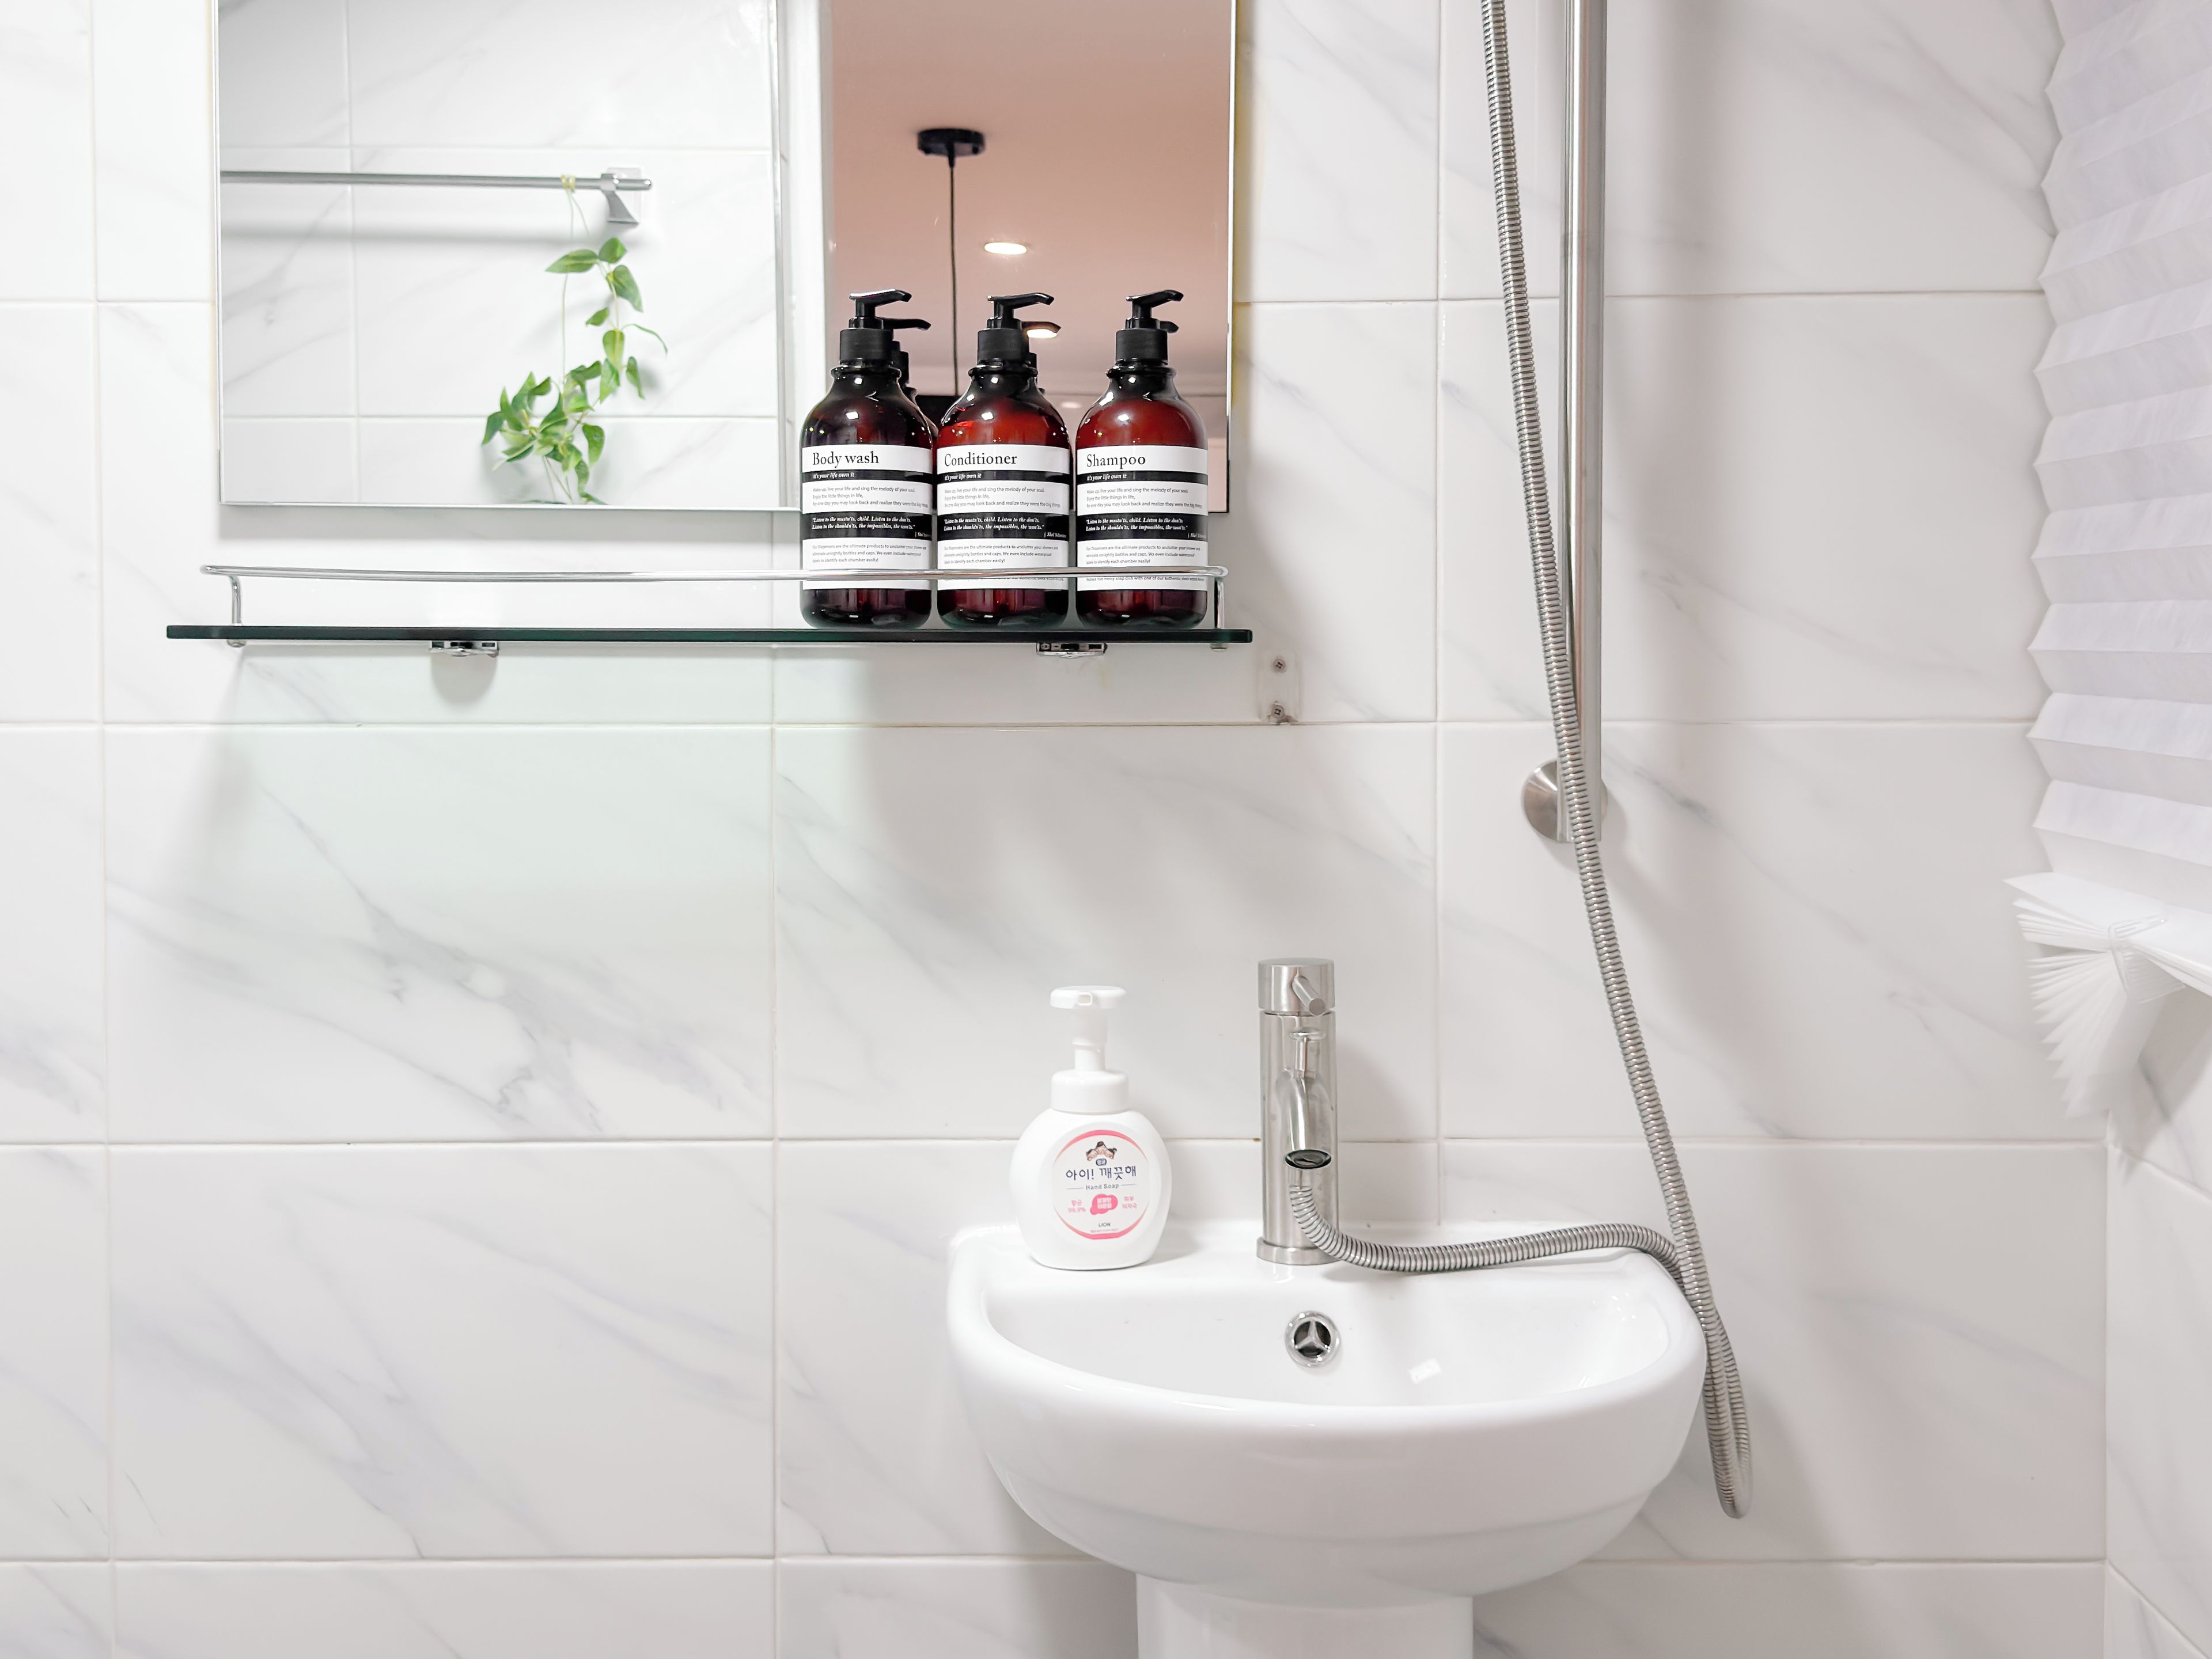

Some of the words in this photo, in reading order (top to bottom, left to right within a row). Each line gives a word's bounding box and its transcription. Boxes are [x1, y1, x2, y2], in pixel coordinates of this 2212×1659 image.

[813, 452, 842, 468] Body
[844, 451, 879, 464] wash
[945, 452, 1017, 467] Conditioner
[1087, 454, 1146, 469] Shampoo
[1066, 1169, 1094, 1180] 아이!
[1099, 1165, 1137, 1180] 깨끗해
